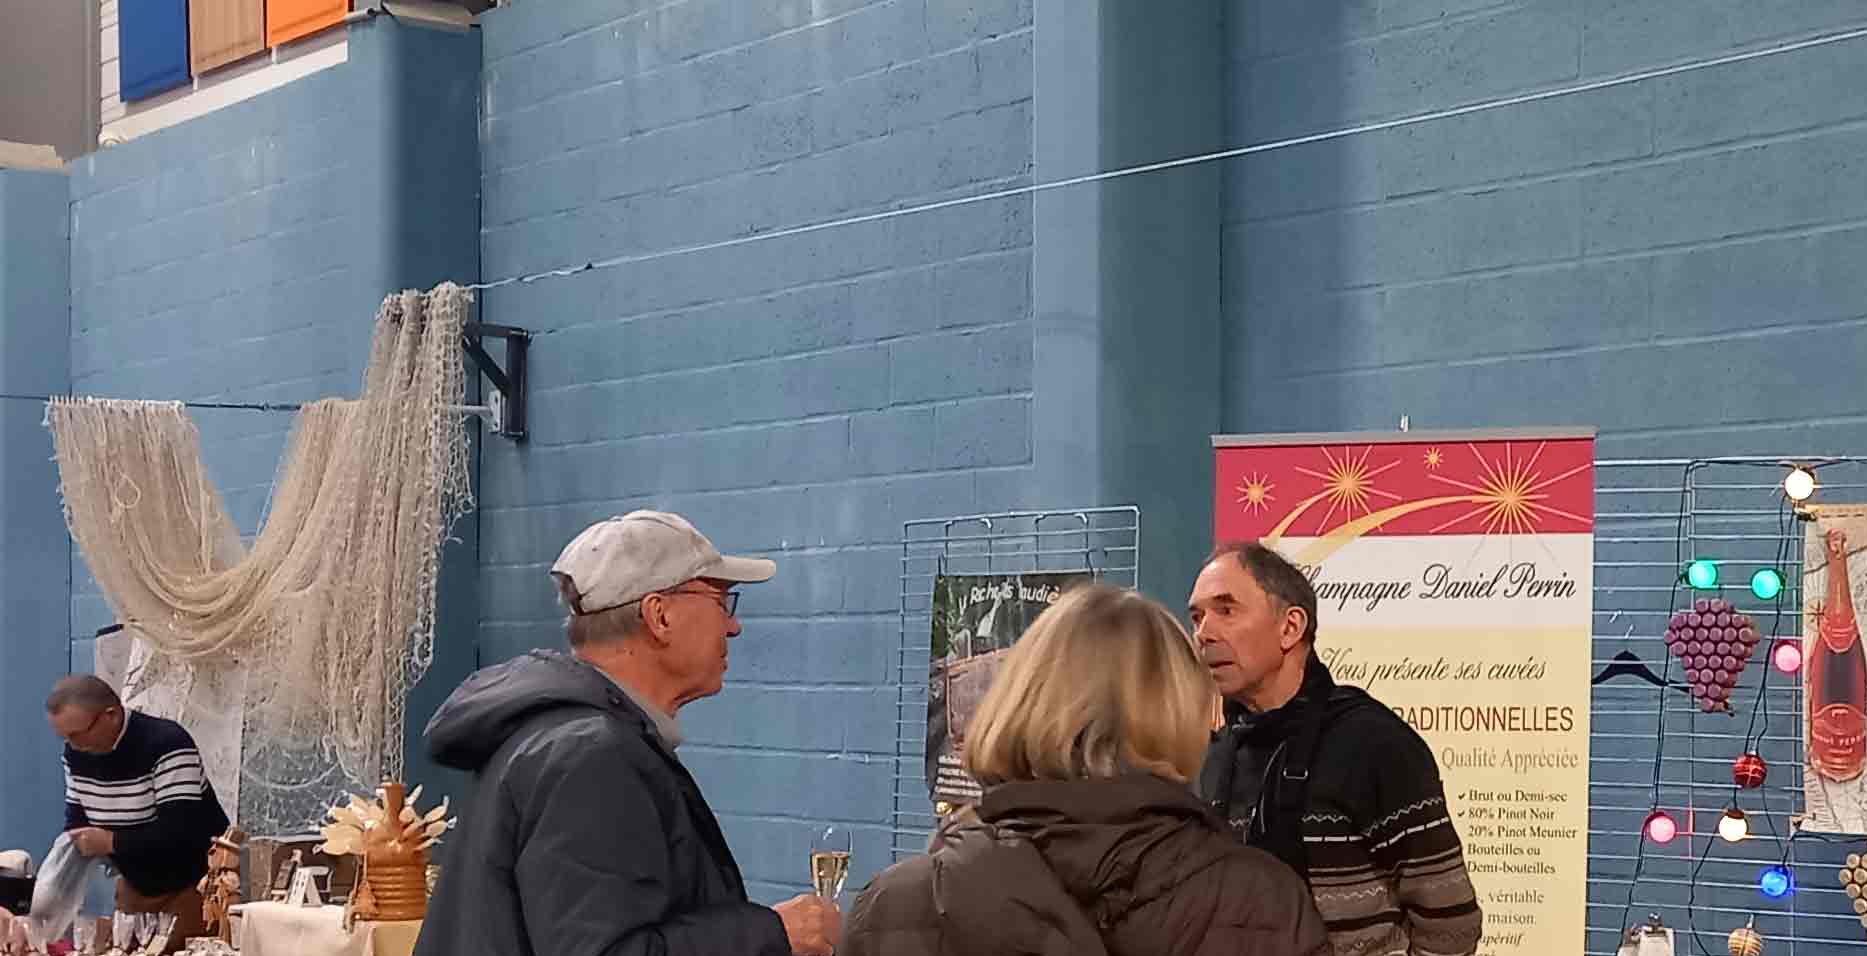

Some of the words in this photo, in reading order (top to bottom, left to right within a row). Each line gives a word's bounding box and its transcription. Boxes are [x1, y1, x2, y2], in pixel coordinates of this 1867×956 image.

[1419, 563, 1508, 600] Daniel
[1503, 562, 1577, 599] Perrin
[1321, 648, 1367, 681] Vous
[1365, 657, 1450, 690] présente
[1453, 660, 1482, 681] ses
[1487, 656, 1546, 681] cuvées
[1395, 706, 1574, 732] ADITIONNELLES
[1442, 746, 1497, 770] Qualité
[1502, 748, 1579, 774] Appréciée
[1469, 789, 1494, 802] Brut
[1497, 793, 1512, 802] ou
[1515, 790, 1568, 803] Demi-sec
[1468, 807, 1495, 820] 80%
[1498, 807, 1530, 821] Pinot
[1534, 808, 1555, 821] Noir
[1467, 825, 1494, 838] 20%
[1497, 825, 1526, 839] Pinot
[1530, 826, 1577, 839] Meunier
[1467, 843, 1524, 856] Bouteilles
[1527, 846, 1541, 856] ou
[1467, 861, 1556, 874] Demi-bouteilles
[1488, 888, 1544, 904] véritable
